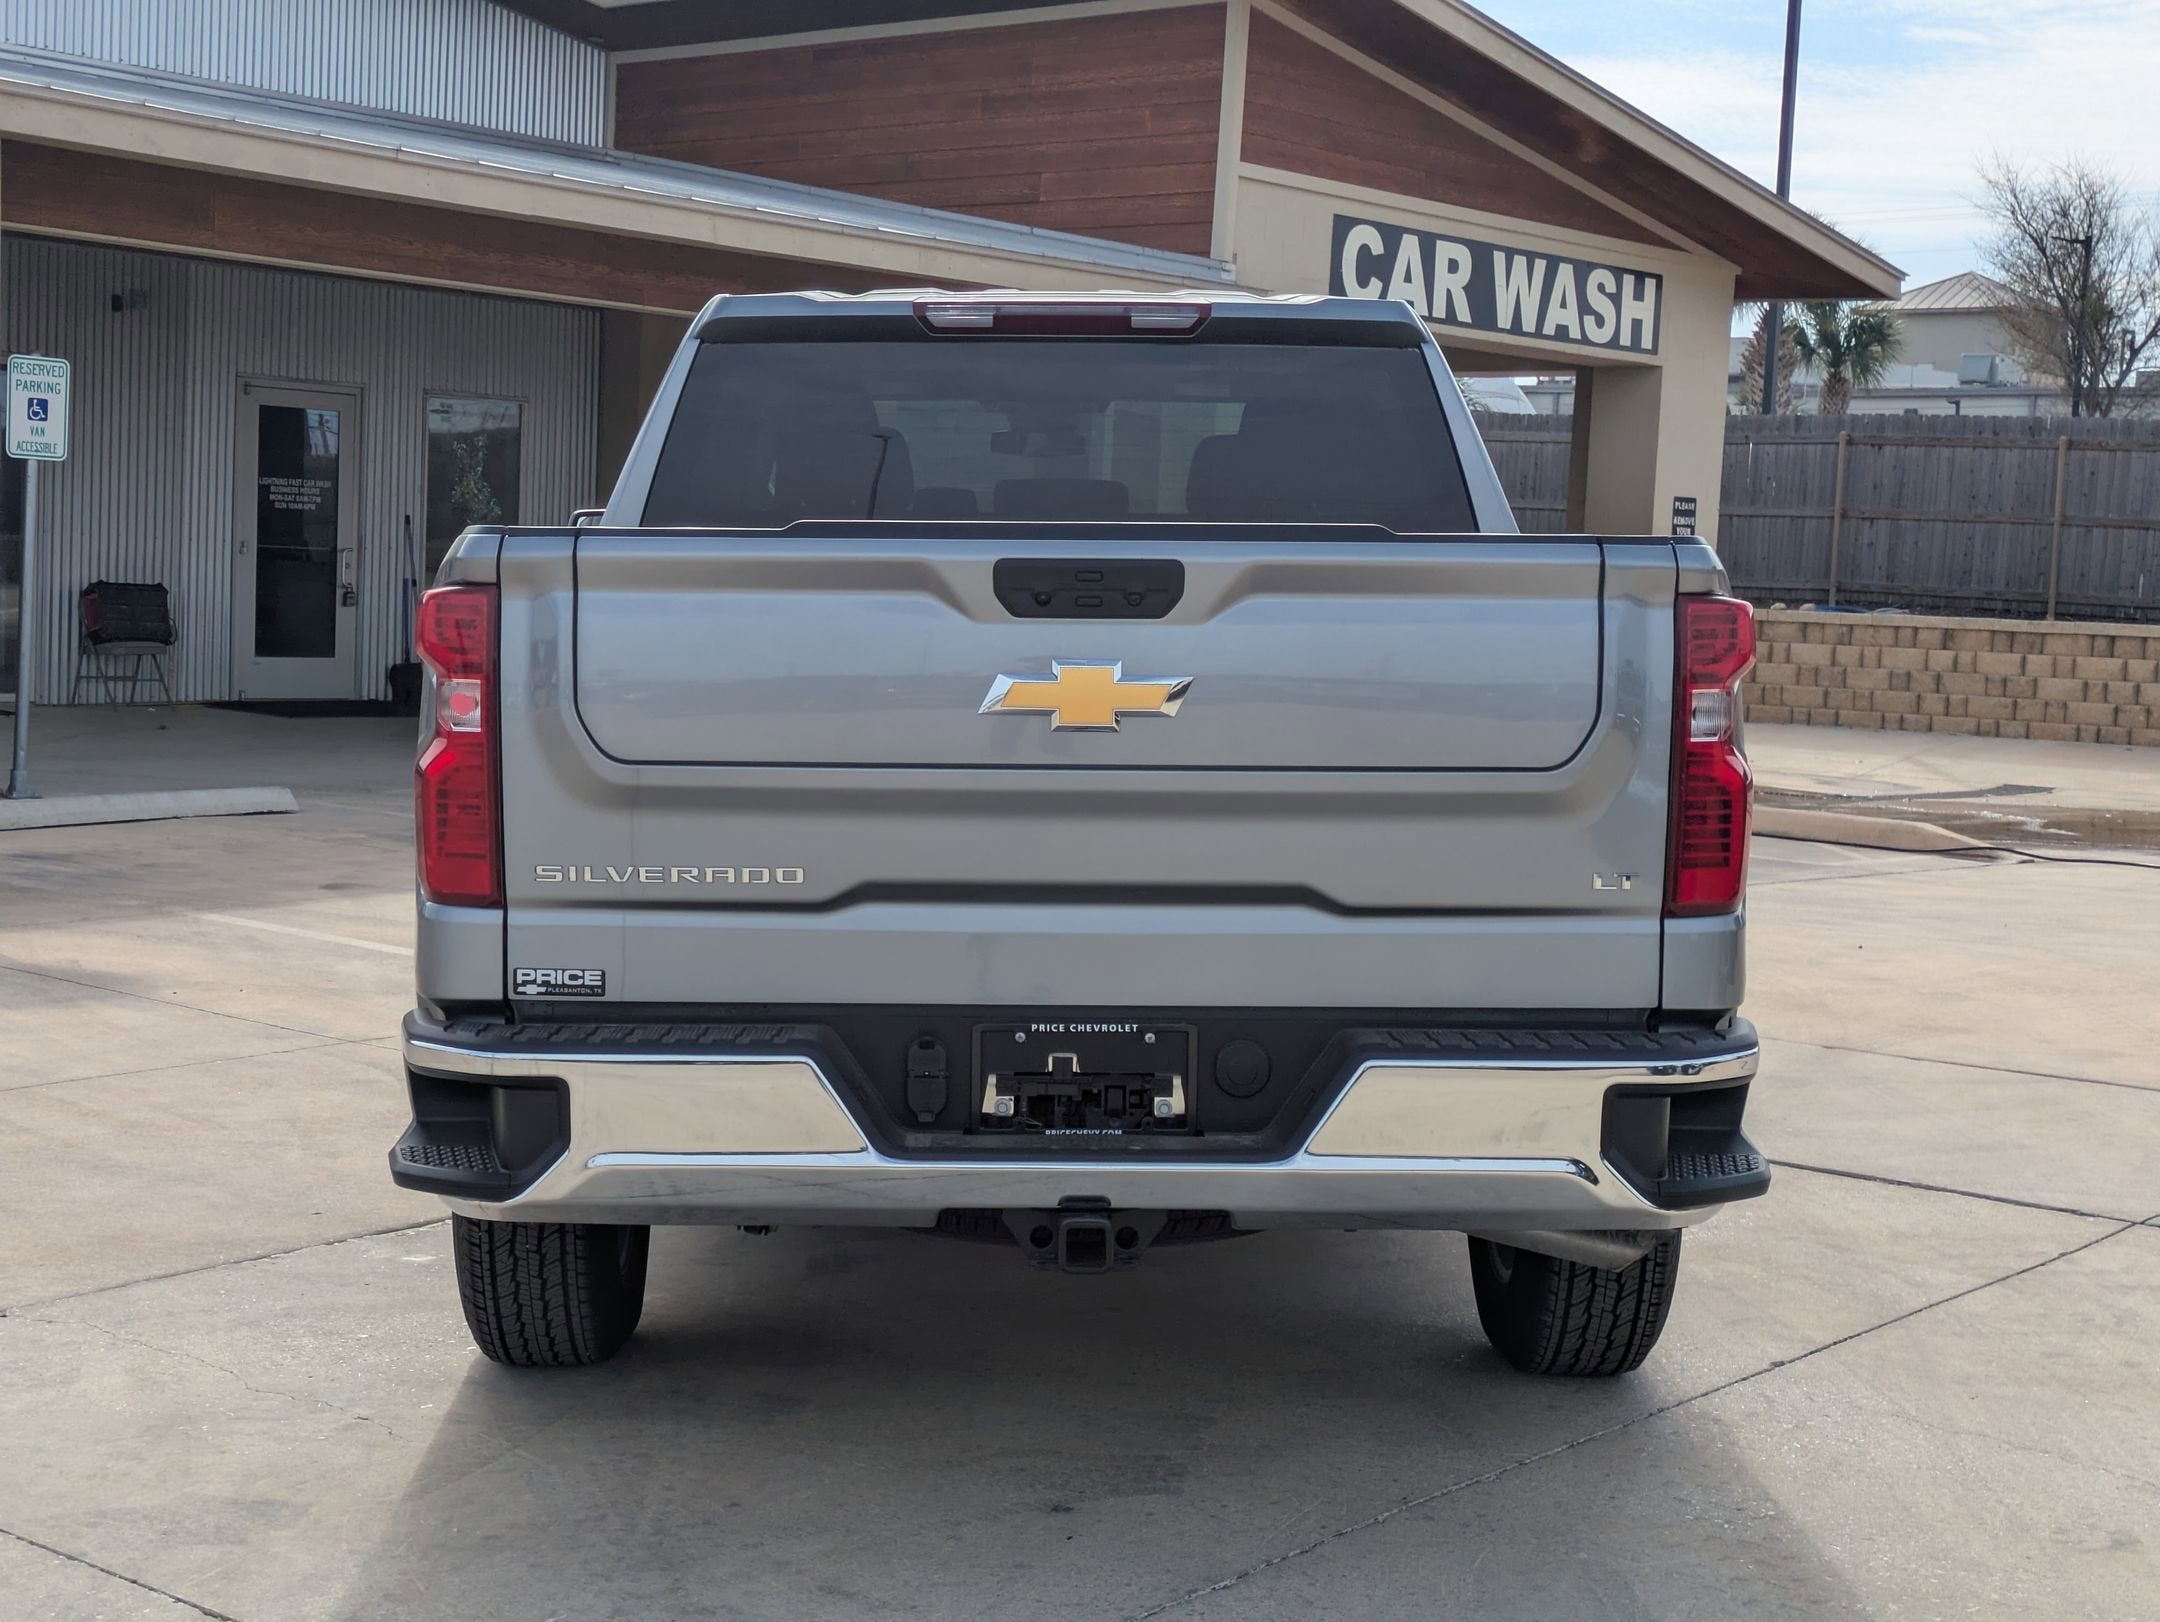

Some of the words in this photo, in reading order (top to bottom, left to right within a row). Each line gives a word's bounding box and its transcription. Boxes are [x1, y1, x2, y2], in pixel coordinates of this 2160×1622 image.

[1342, 224, 1473, 324] CAR
[1493, 250, 1657, 350] WASH
[12, 361, 65, 378] RESERVED
[15, 379, 61, 395] PARKING
[30, 426, 46, 437] VAN
[16, 440, 57, 454] ACCESSIBLE
[289, 478, 303, 487] FAST
[303, 479, 315, 487] CAR
[1675, 501, 1695, 510] PLEASE
[1673, 516, 1695, 526] REMOVE
[535, 865, 805, 884] SILVERADO
[1592, 872, 1640, 890] LT
[516, 968, 602, 985] PRICE
[1031, 1023, 1066, 1032] PRICE
[1069, 1023, 1139, 1033] CHEVROLET
